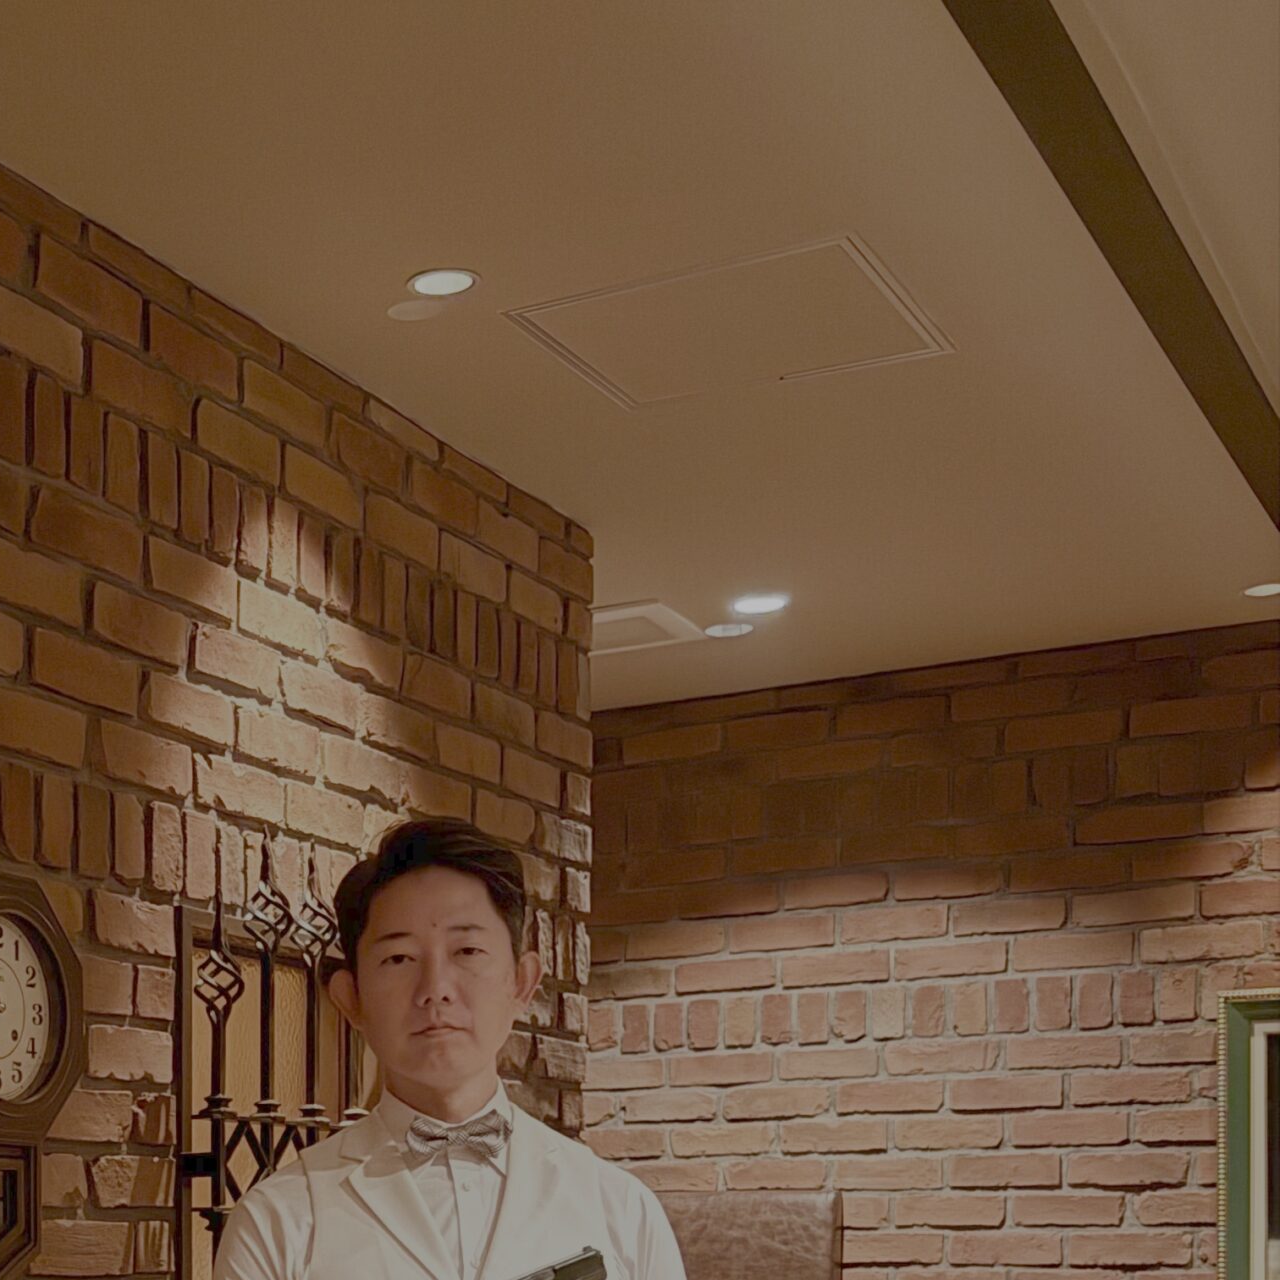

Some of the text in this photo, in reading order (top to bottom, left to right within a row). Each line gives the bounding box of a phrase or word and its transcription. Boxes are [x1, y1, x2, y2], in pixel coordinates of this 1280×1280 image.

[13, 938, 20, 962] 1
[25, 965, 37, 988] 2
[31, 1003, 43, 1026] 3
[25, 1037, 37, 1059] 4
[12, 1061, 23, 1084] 5
